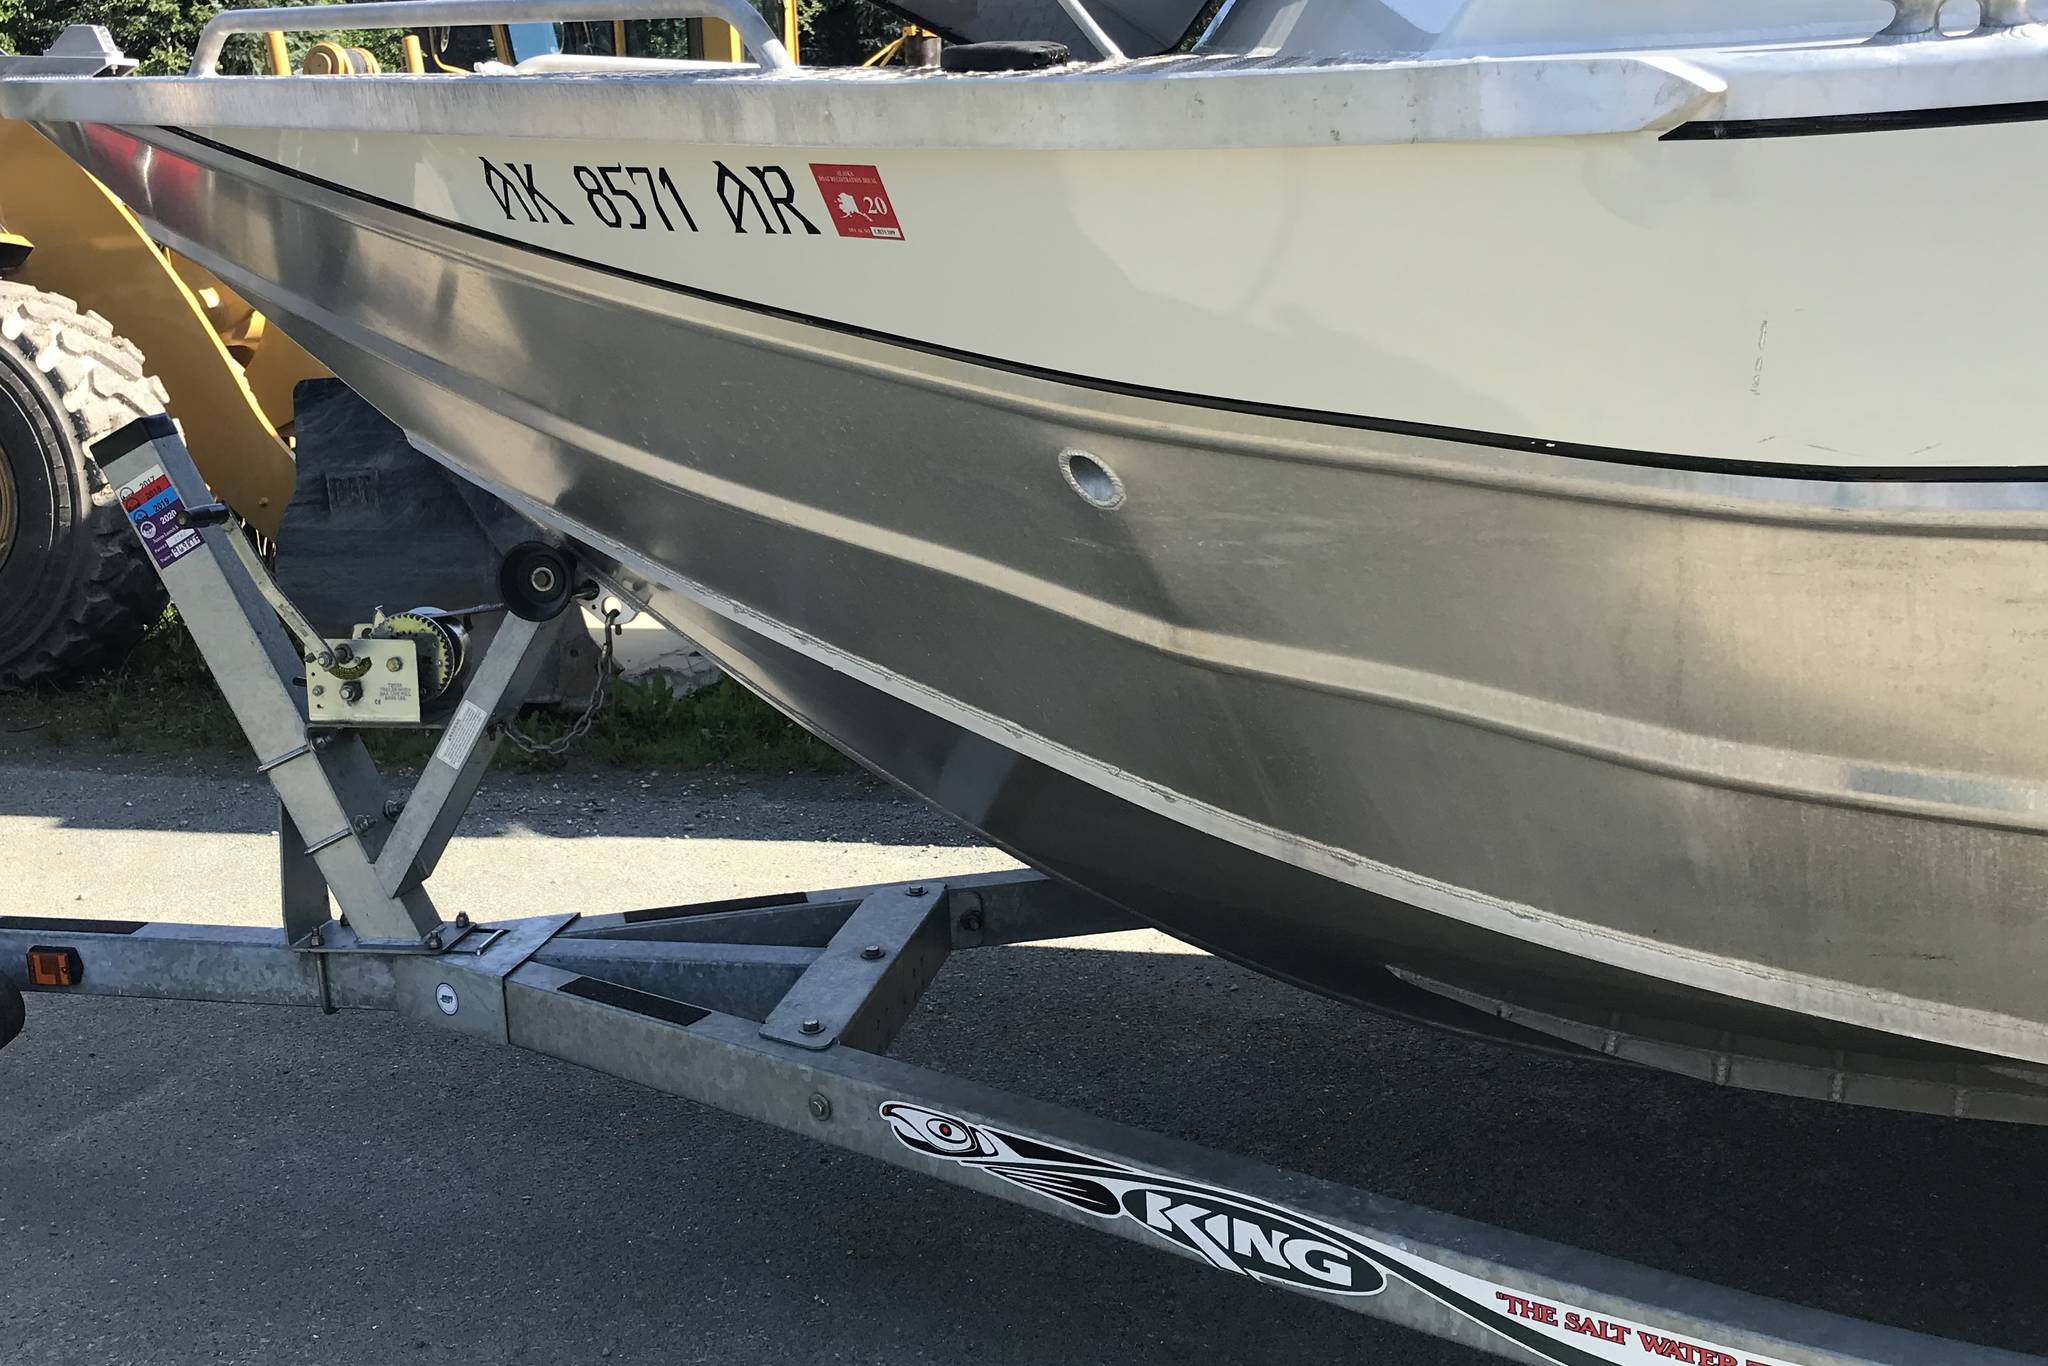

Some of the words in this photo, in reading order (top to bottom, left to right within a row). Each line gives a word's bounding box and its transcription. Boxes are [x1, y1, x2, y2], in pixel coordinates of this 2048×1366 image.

[478, 156, 575, 226] AK
[573, 162, 699, 232] 8571
[712, 160, 822, 235] AR
[863, 196, 888, 215] 20
[139, 475, 155, 489] 2017
[153, 497, 170, 513] 2019
[159, 509, 177, 525] 2020
[1146, 1191, 1352, 1286] KING
[1564, 1311, 1631, 1345] SALT
[1637, 1330, 1738, 1366] WATER
